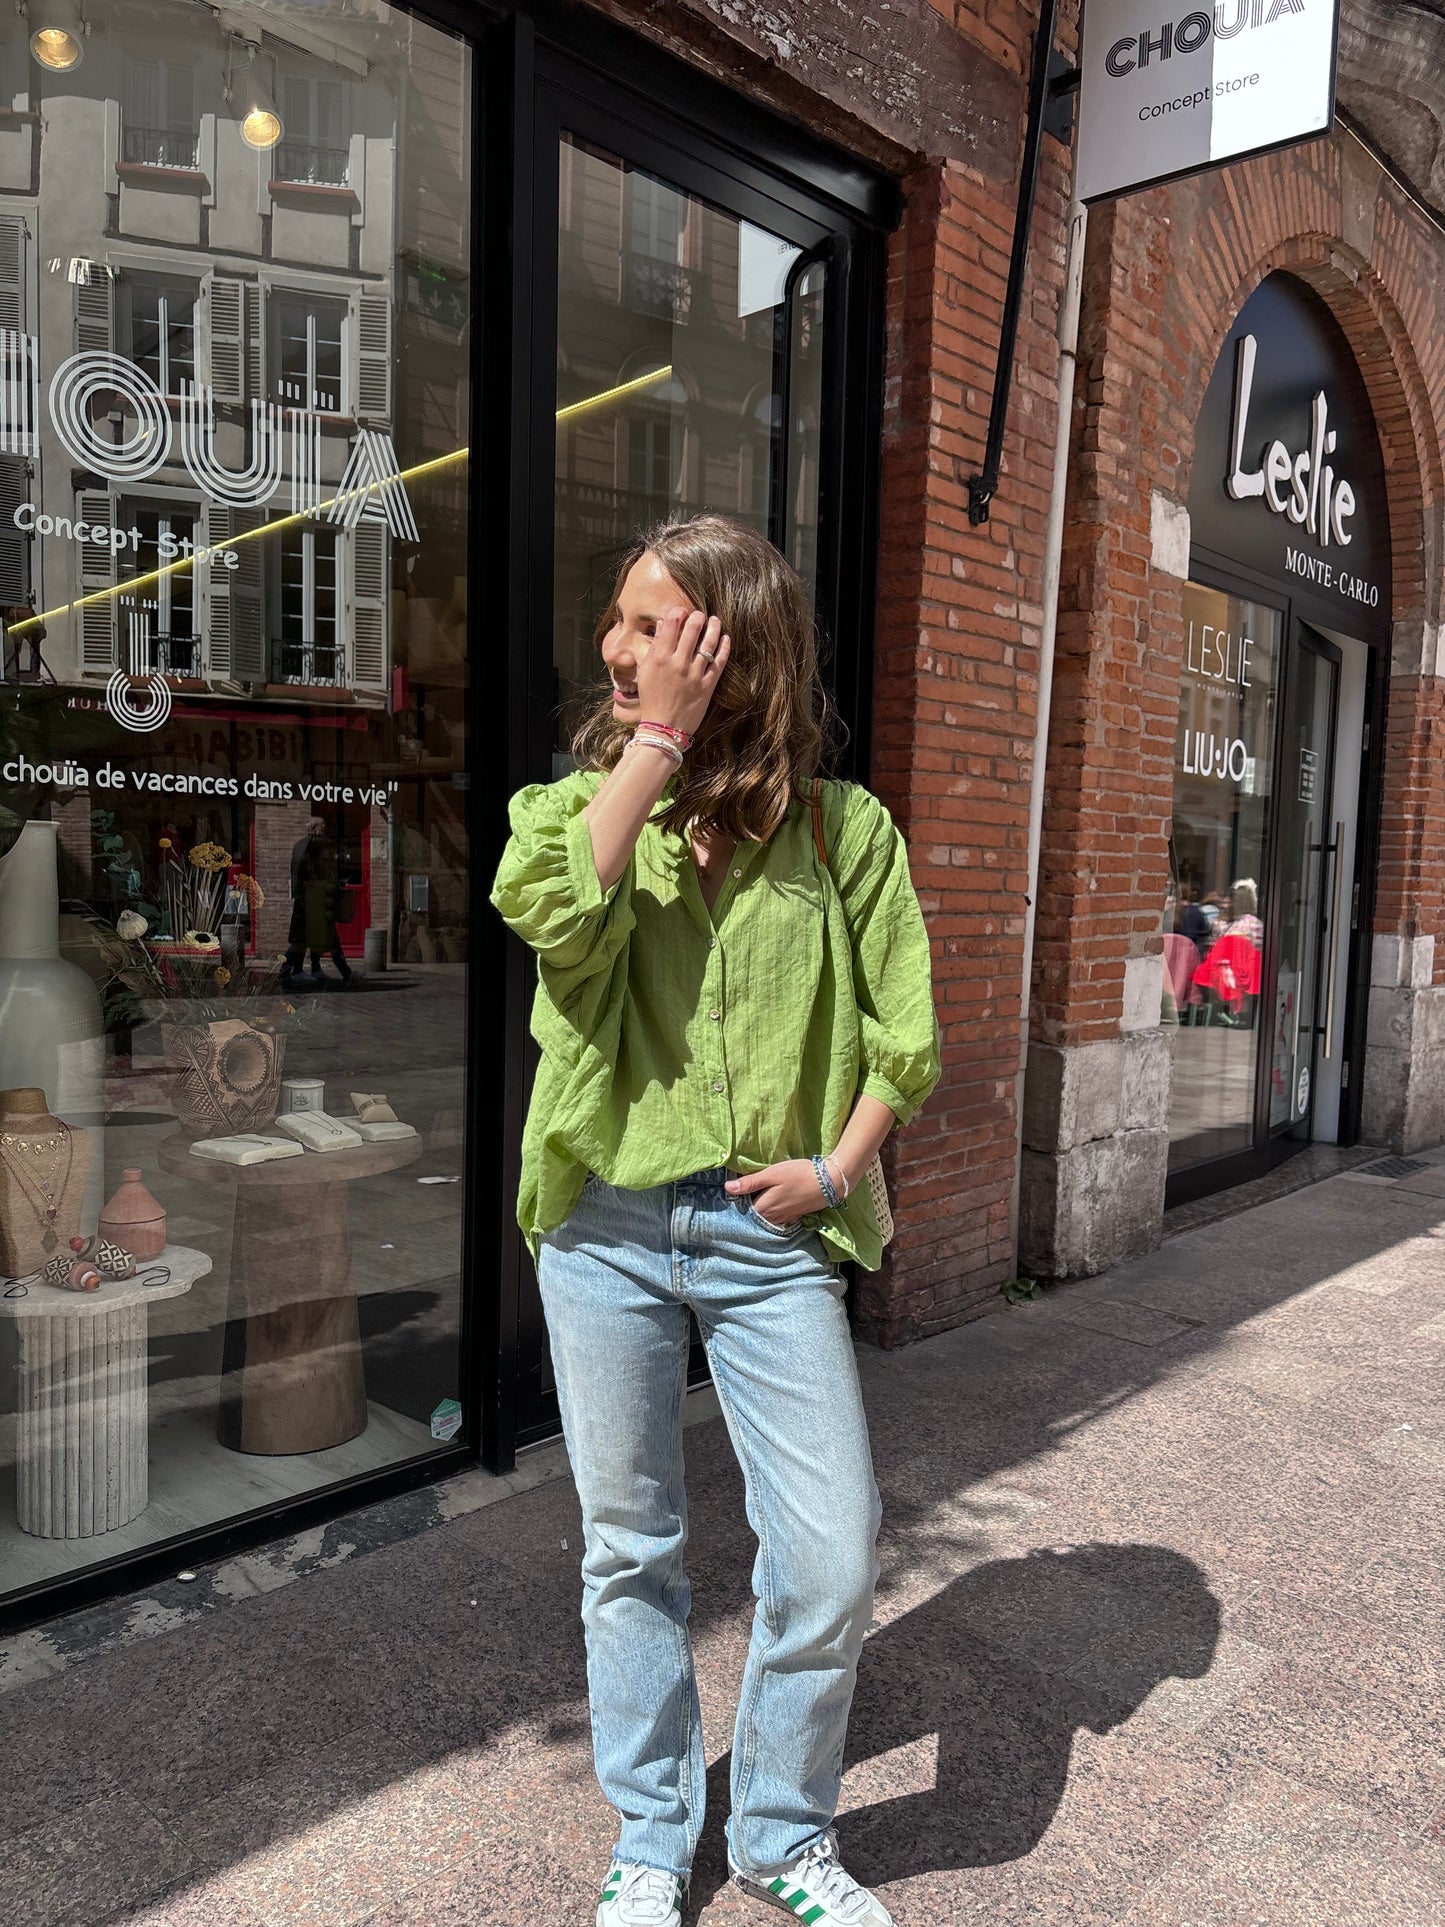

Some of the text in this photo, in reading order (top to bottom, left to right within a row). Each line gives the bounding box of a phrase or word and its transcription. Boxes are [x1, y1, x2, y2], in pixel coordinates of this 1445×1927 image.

[1138, 73, 1260, 121] Concept Store
[1228, 334, 1356, 547] Leslie
[13, 503, 239, 569] Concept Store
[1187, 620, 1254, 688] LESLIE
[3, 755, 89, 787] chouïa
[96, 762, 126, 788] de
[132, 771, 239, 796] vacances
[244, 773, 293, 799] dans
[298, 781, 354, 804] votre
